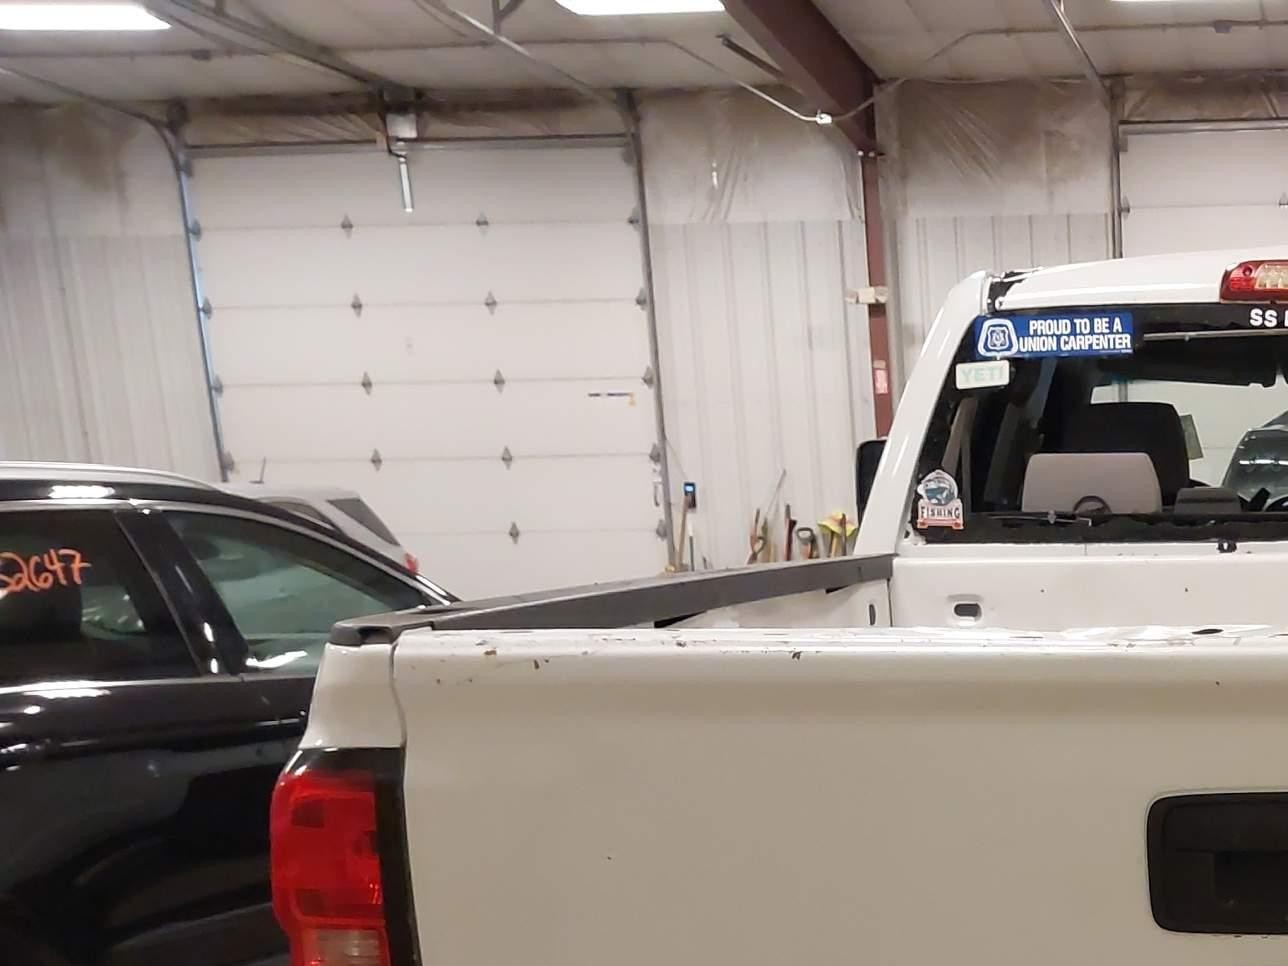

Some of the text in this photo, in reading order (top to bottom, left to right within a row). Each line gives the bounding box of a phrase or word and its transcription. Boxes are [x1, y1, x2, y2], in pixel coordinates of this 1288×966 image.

[1029, 317, 1122, 336] PROUD TO BE A
[1249, 308, 1278, 328] SS
[1019, 334, 1131, 352] UNION CARPENTER
[960, 366, 1004, 384] YETI
[920, 506, 960, 519] FISHING
[0, 548, 92, 592] 2647
